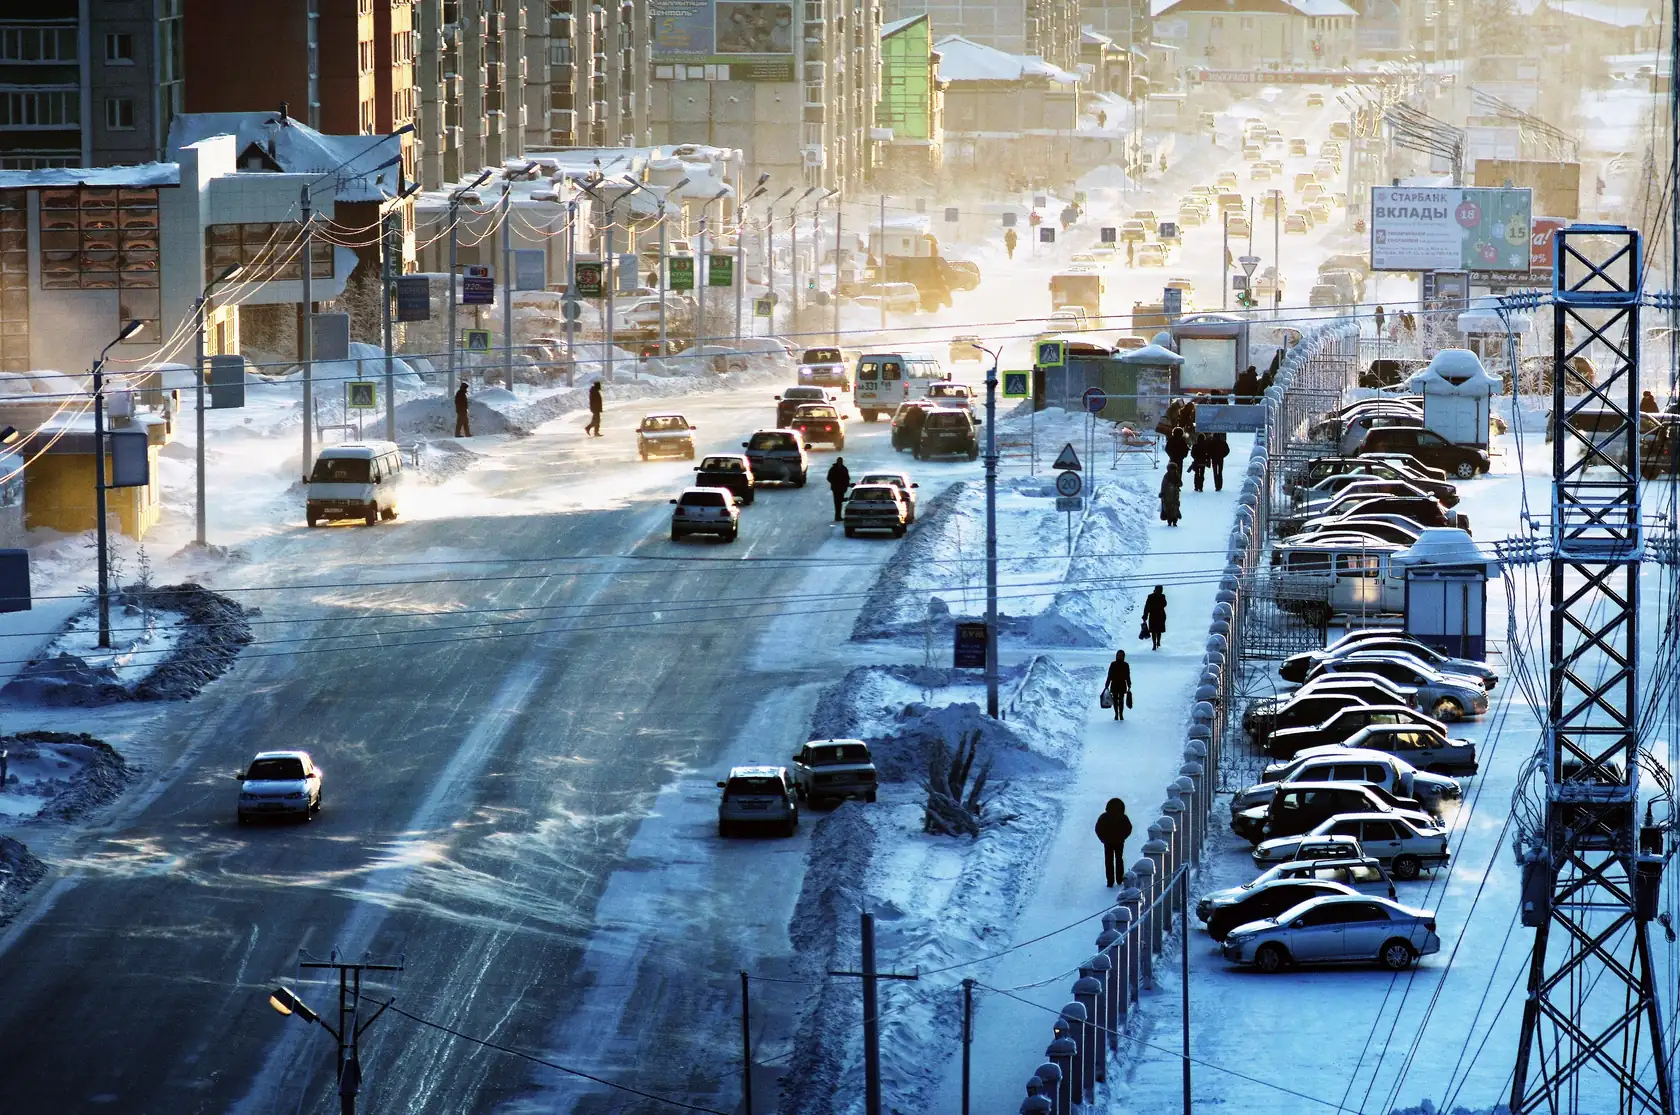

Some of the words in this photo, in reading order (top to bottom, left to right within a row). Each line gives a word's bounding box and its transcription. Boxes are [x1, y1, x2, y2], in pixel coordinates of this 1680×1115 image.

[1376, 207, 1447, 220] ВКЛАДЫ
[1460, 210, 1475, 219] 18
[1509, 227, 1526, 238] 15
[1531, 228, 1553, 246] а!
[389, 220, 397, 288] АПТЕКА
[865, 382, 878, 390] 331
[1061, 478, 1076, 490] 20
